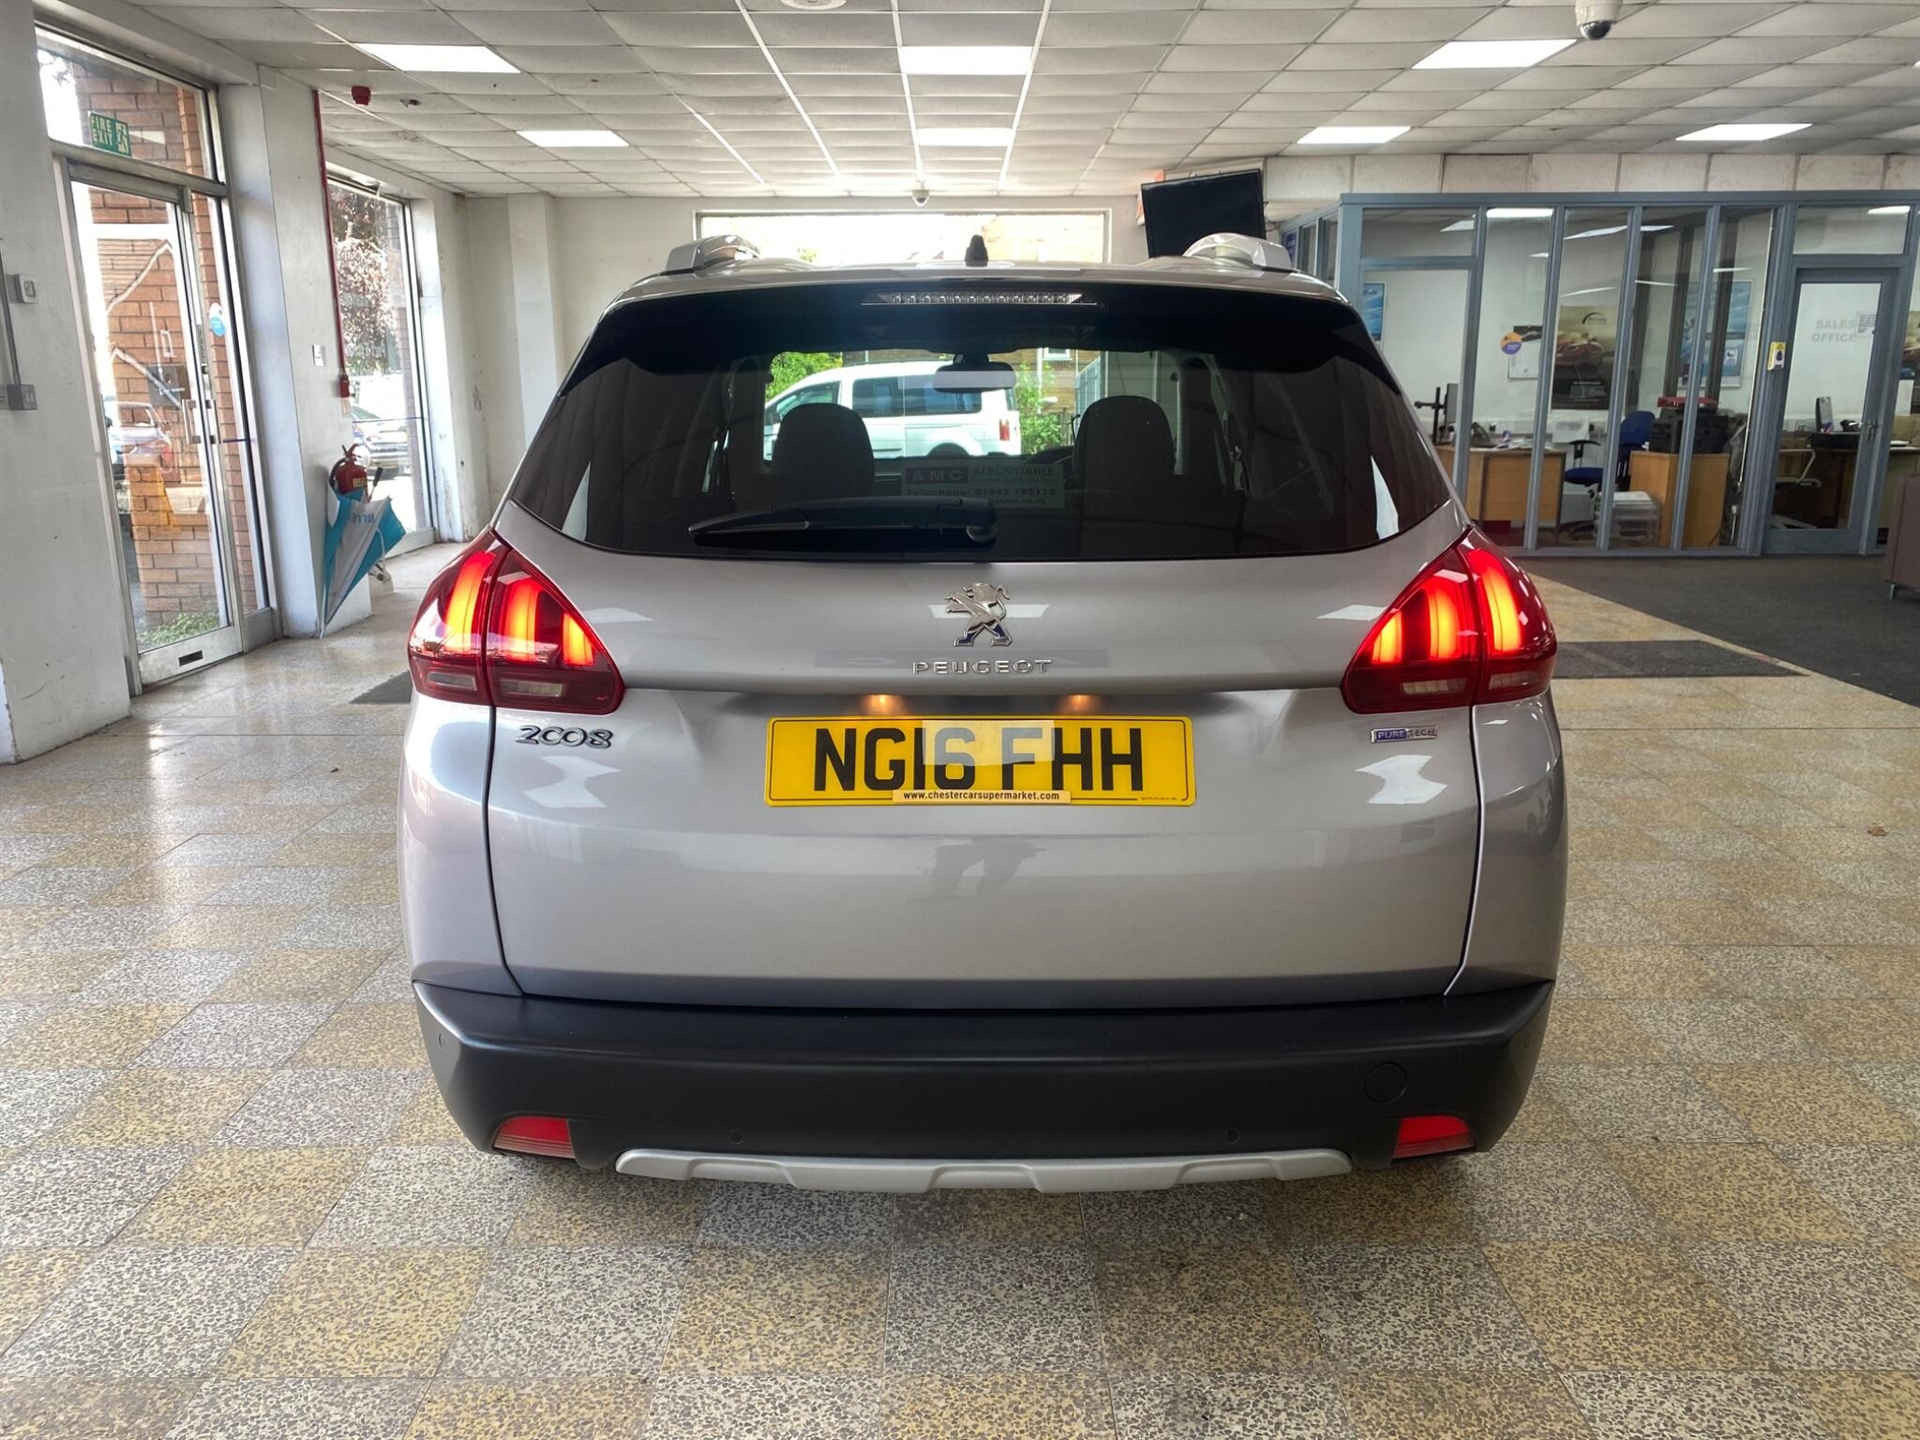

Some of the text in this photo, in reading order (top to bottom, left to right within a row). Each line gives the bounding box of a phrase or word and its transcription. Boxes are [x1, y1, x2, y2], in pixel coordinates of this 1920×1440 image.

[91, 115, 112, 133] FIRE
[92, 129, 113, 146] EXIT
[1816, 319, 1857, 329] SALES
[1811, 333, 1856, 343] OFFICE
[911, 467, 1055, 481] AMC AFFORDABLE
[912, 659, 1053, 675] PEUGEOT
[515, 725, 614, 749] 2008
[814, 727, 1144, 791] NG16 FHH
[903, 790, 1061, 801] www.chestercarsupermarket.com
